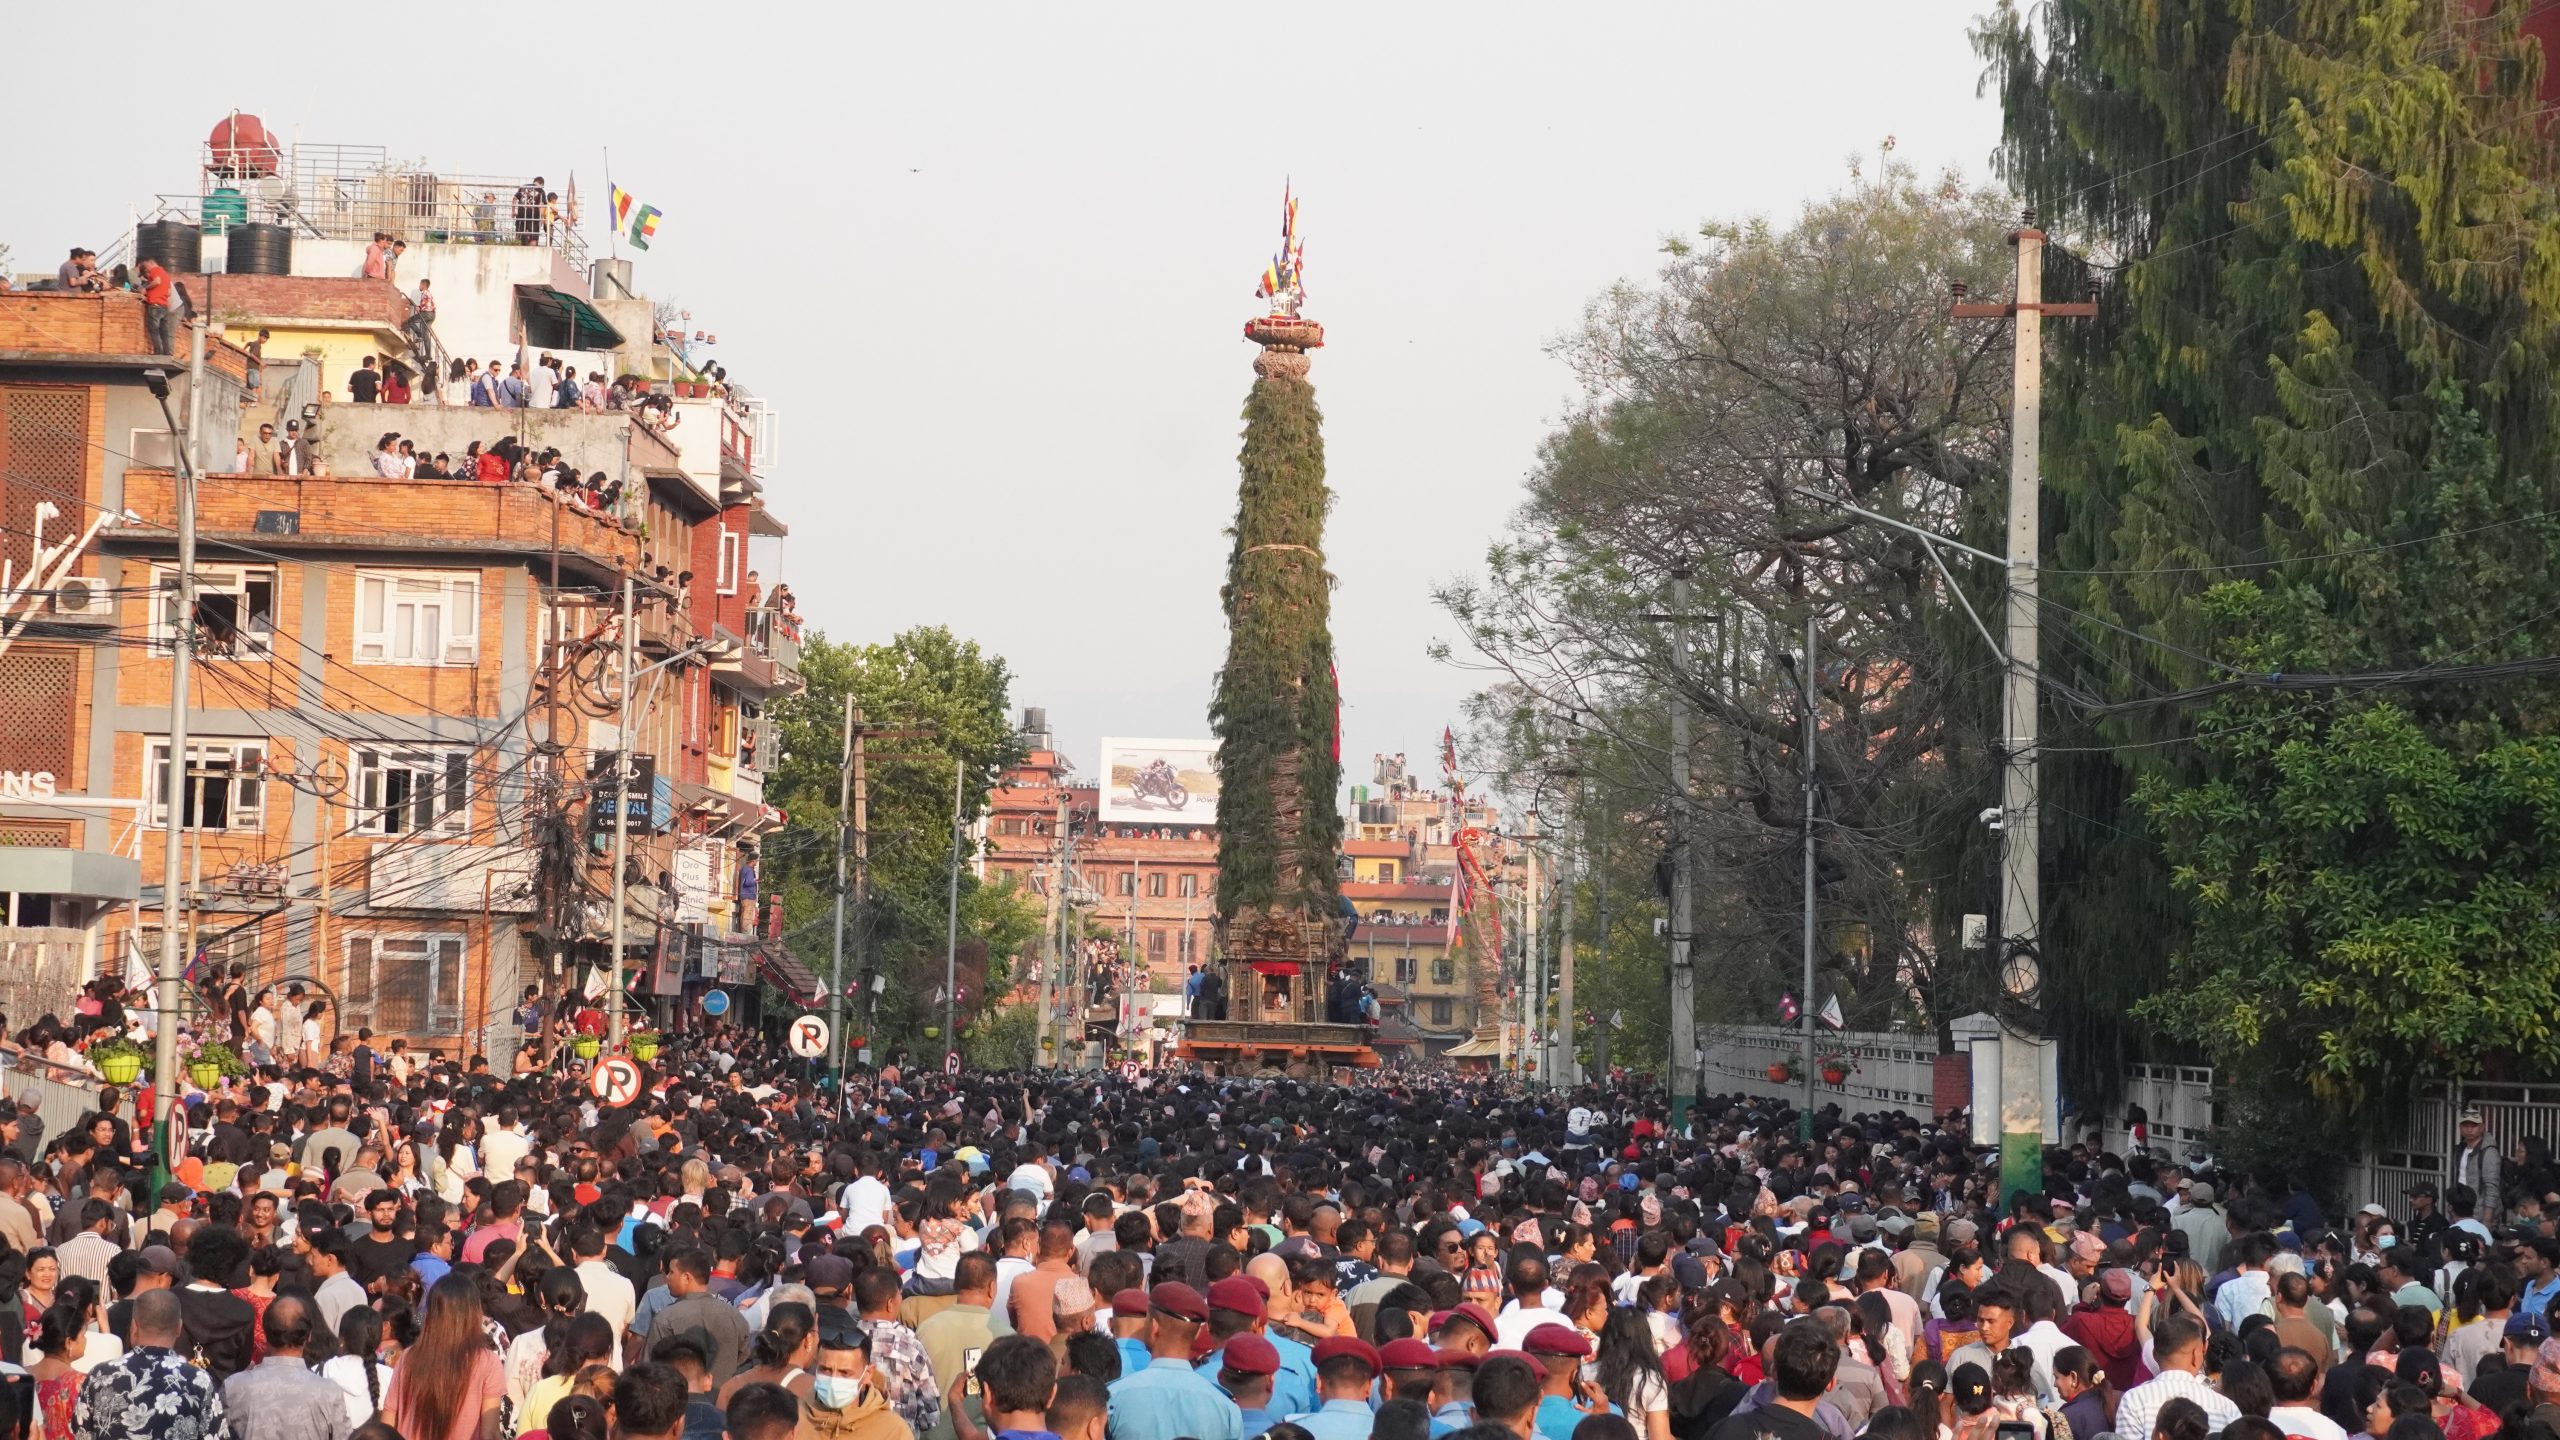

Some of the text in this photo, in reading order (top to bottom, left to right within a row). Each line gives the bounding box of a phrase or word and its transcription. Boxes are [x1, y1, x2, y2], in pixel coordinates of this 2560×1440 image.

[0, 770, 56, 800] NS
[628, 792, 648, 800] SMILE
[597, 800, 648, 815] DETAL
[682, 860, 699, 869] Oro
[681, 872, 700, 881] Plus
[675, 883, 706, 894] Dental
[802, 1024, 821, 1049] P
[605, 1066, 631, 1097] P
